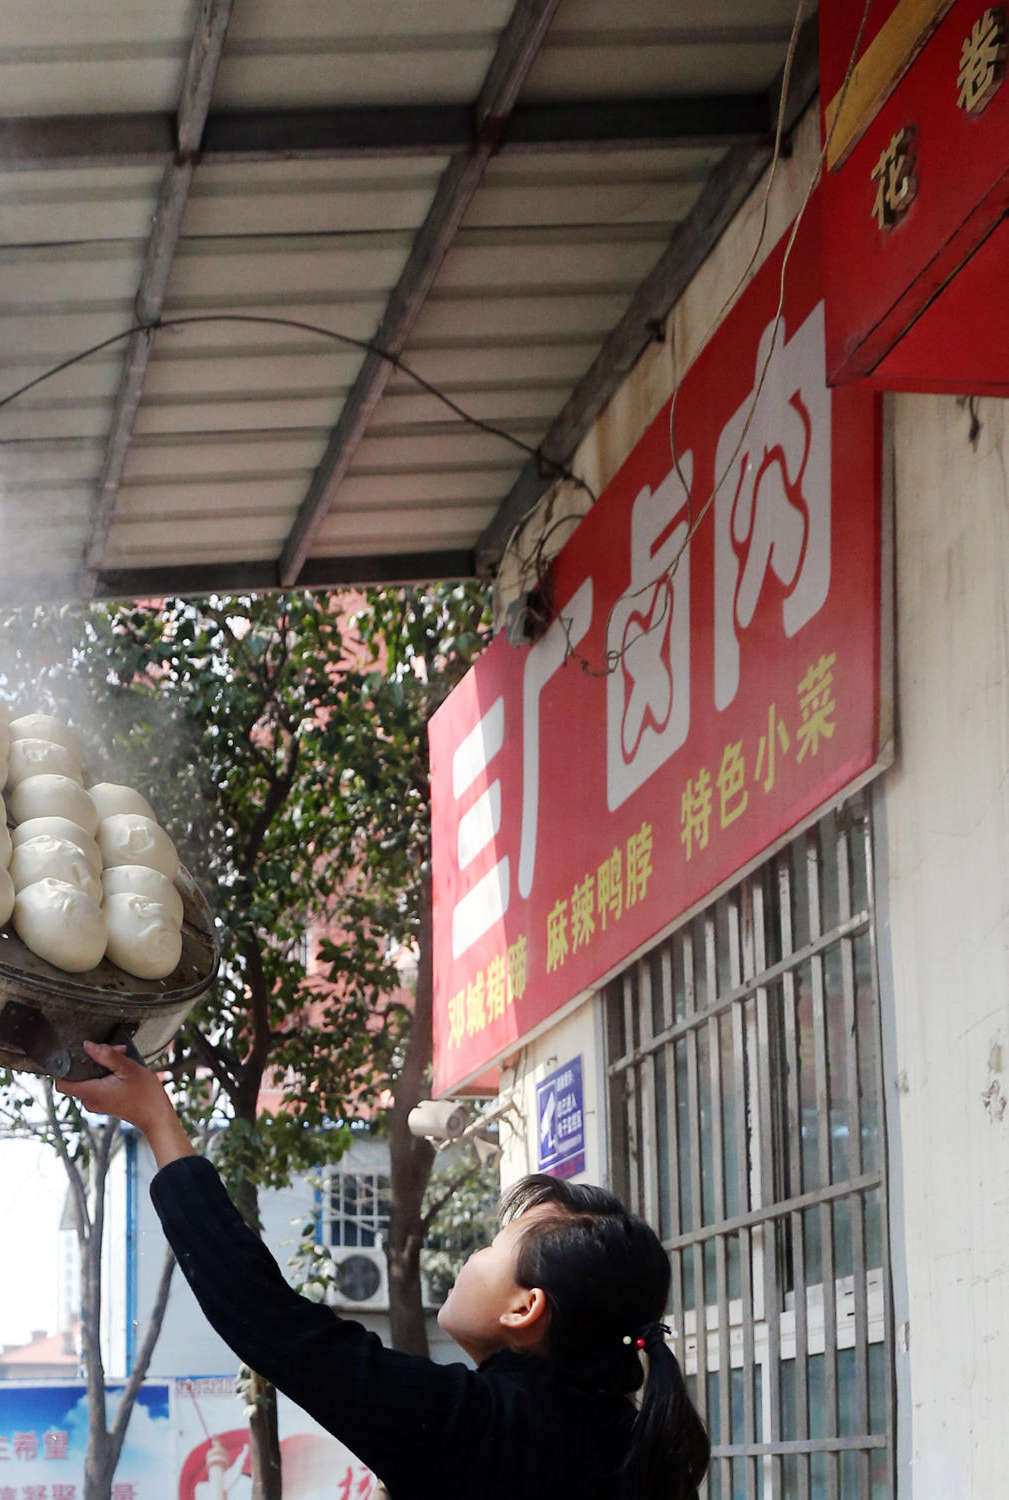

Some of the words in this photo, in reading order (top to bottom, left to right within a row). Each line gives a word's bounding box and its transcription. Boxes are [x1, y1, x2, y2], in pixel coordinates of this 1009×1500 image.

[546, 821, 653, 974] 麻辣鸭脖
[680, 651, 836, 861] 特色小菜
